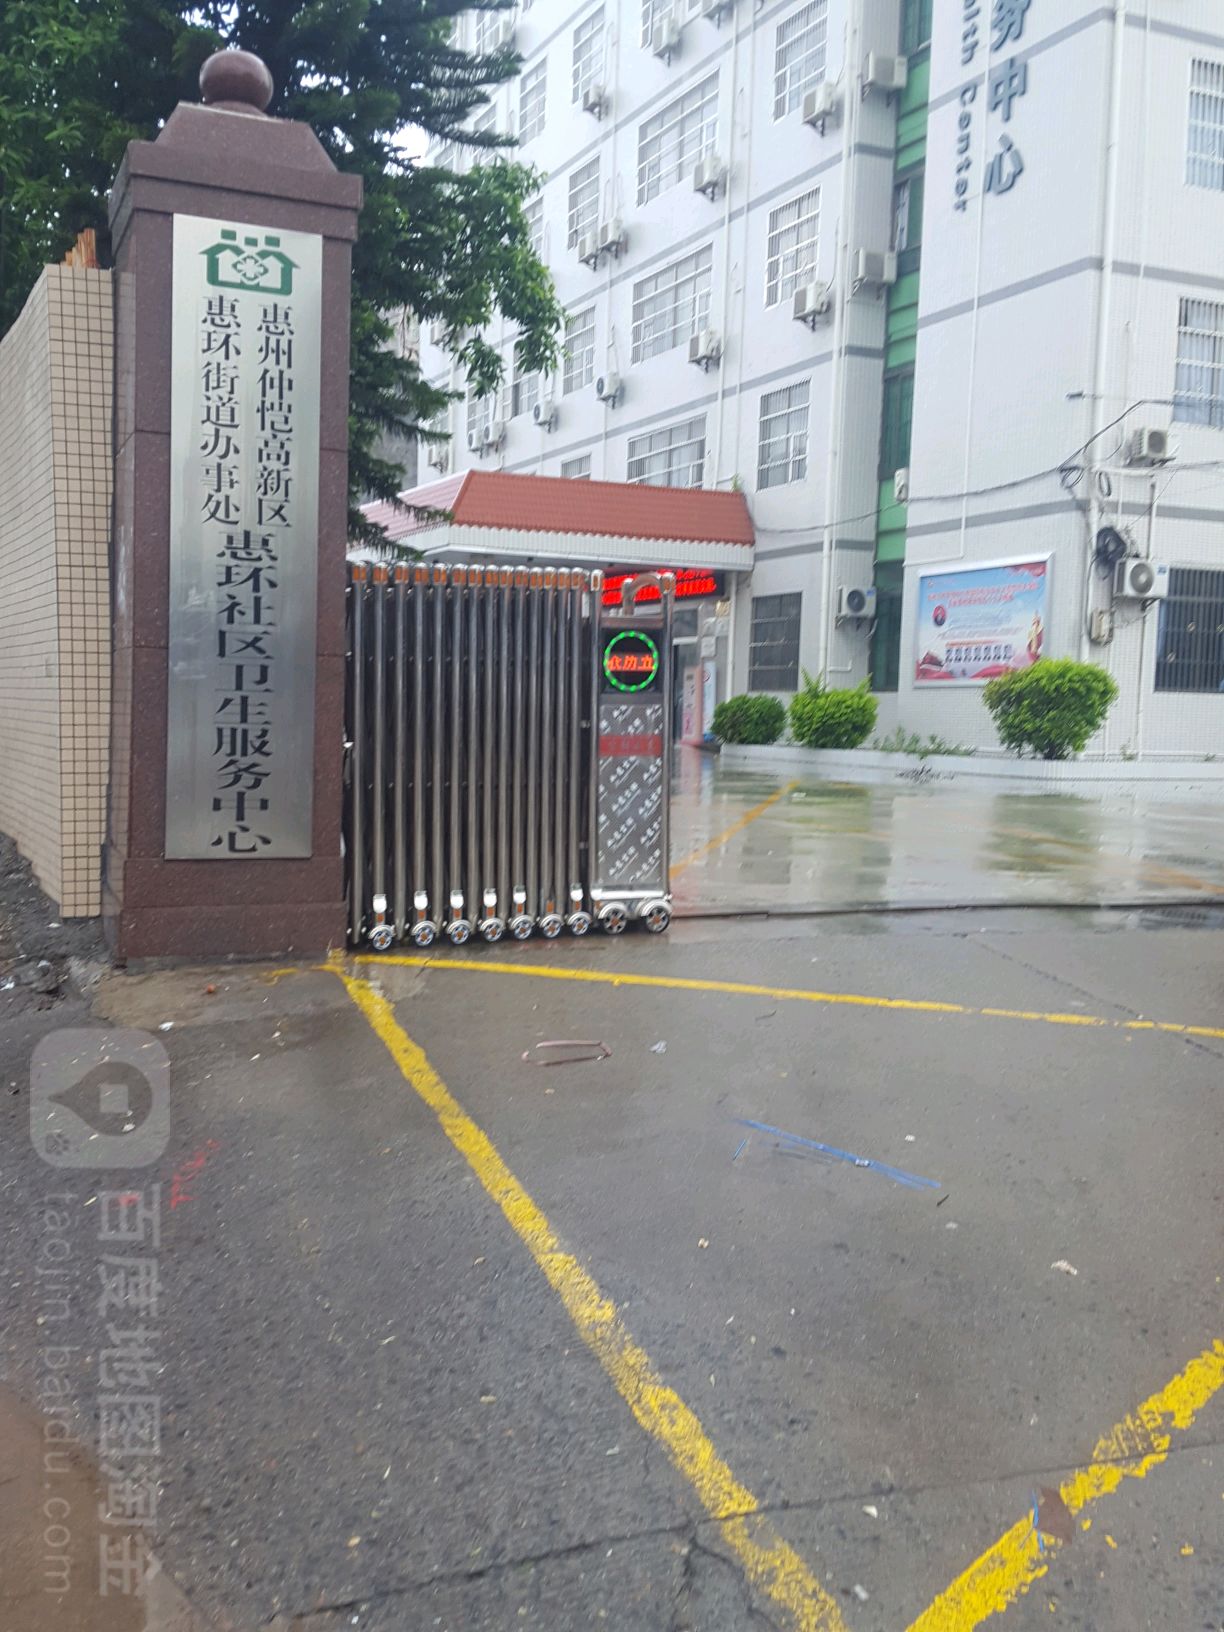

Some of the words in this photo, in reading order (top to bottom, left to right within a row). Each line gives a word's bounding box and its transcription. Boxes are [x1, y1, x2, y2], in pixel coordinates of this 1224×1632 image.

[954, 83, 977, 212] Center
[200, 295, 241, 526] 惠环街道办事处
[256, 302, 294, 527] 惠州仲恺高新区
[210, 530, 278, 853] 惠环社区卫生服务中心
